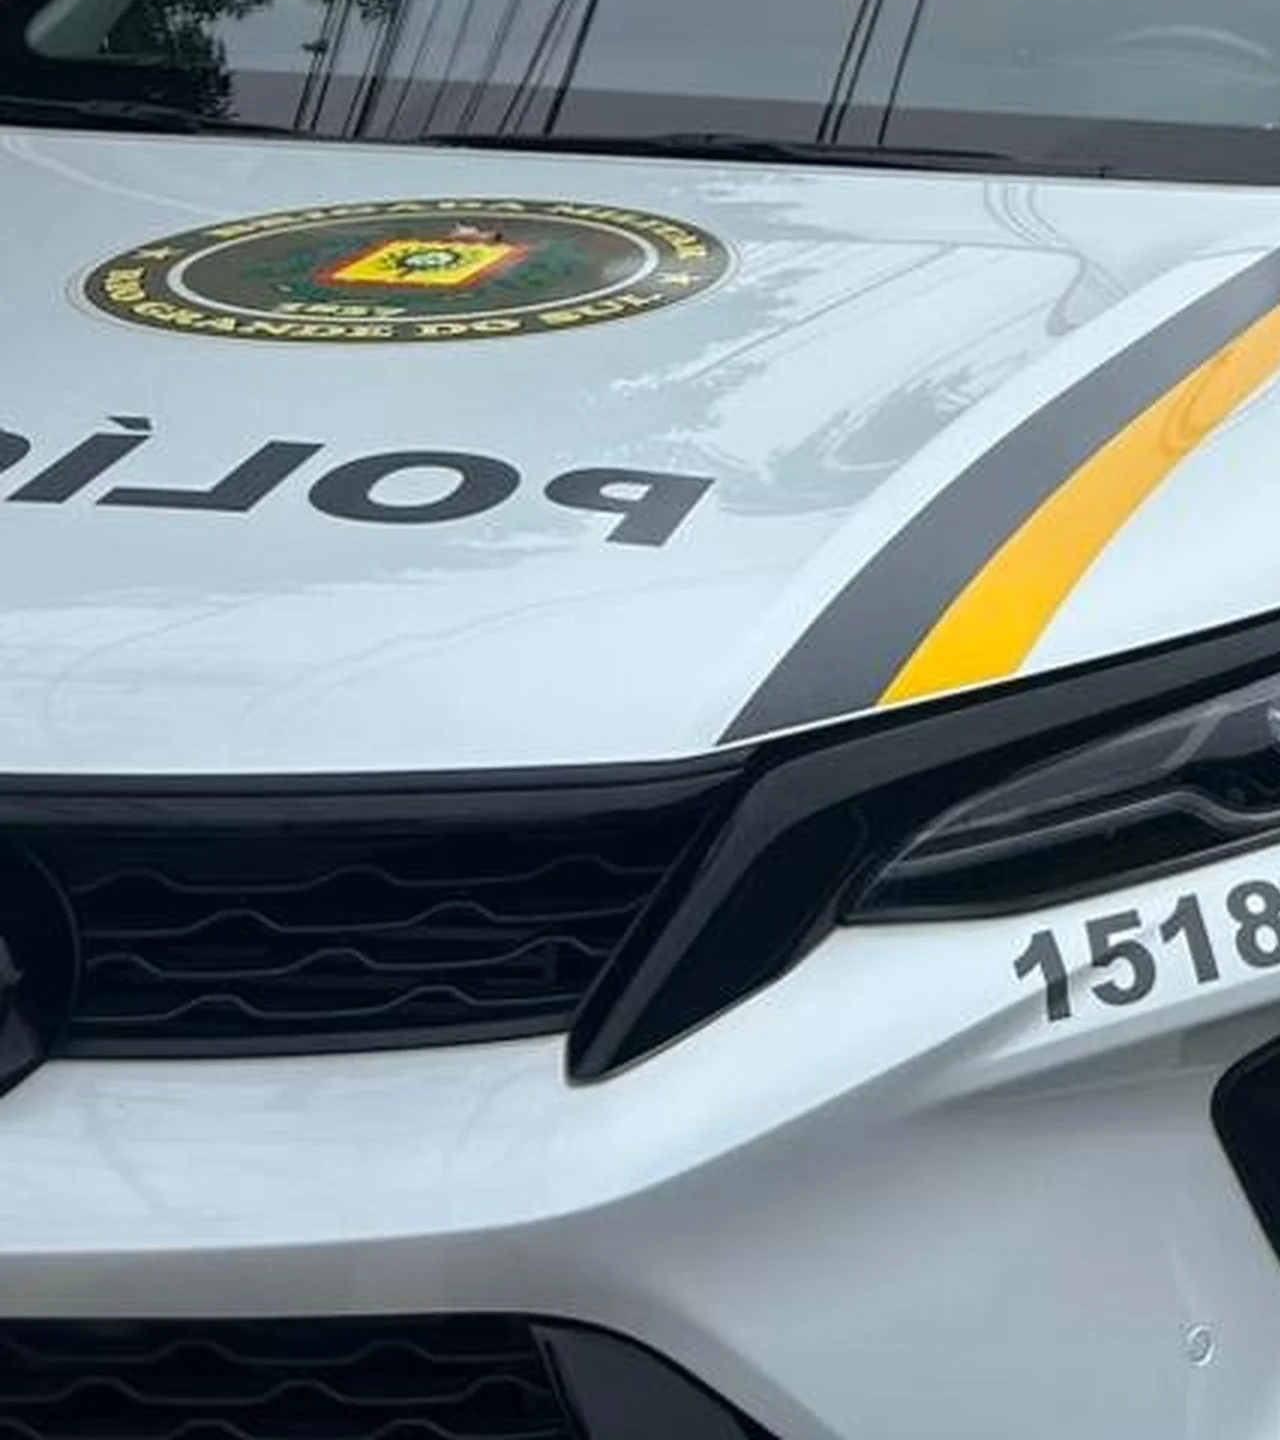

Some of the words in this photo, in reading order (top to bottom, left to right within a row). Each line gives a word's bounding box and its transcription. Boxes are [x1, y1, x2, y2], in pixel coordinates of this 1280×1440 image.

[133, 302, 394, 337] GRANDE
[414, 318, 522, 338] DO
[537, 293, 663, 328] SUL
